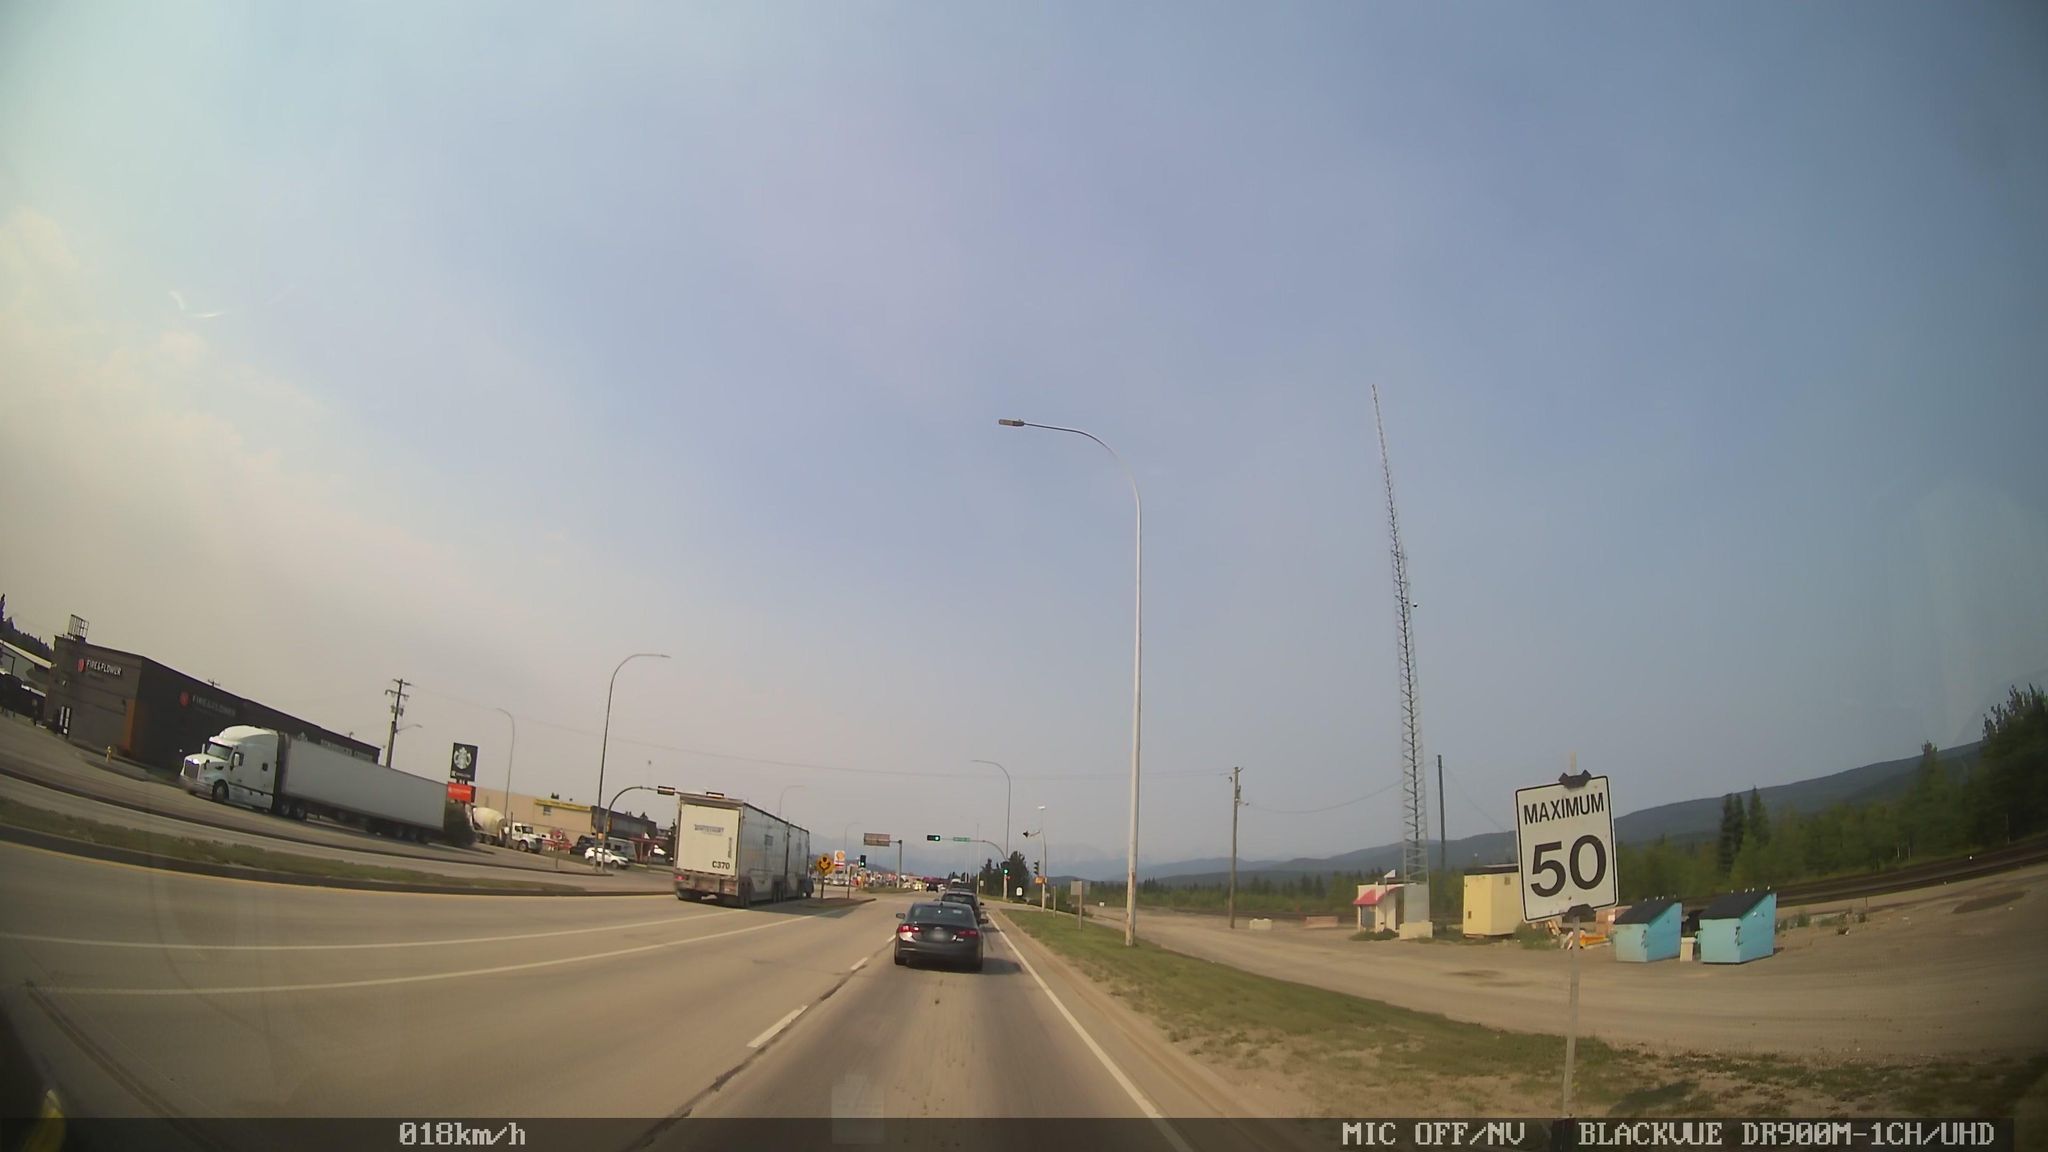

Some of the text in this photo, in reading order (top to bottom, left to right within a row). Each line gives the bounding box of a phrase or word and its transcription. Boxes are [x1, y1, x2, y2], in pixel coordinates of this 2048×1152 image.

[1524, 792, 1605, 825] MAXIMUM
[712, 860, 730, 870] C370
[1531, 834, 1607, 898] 50
